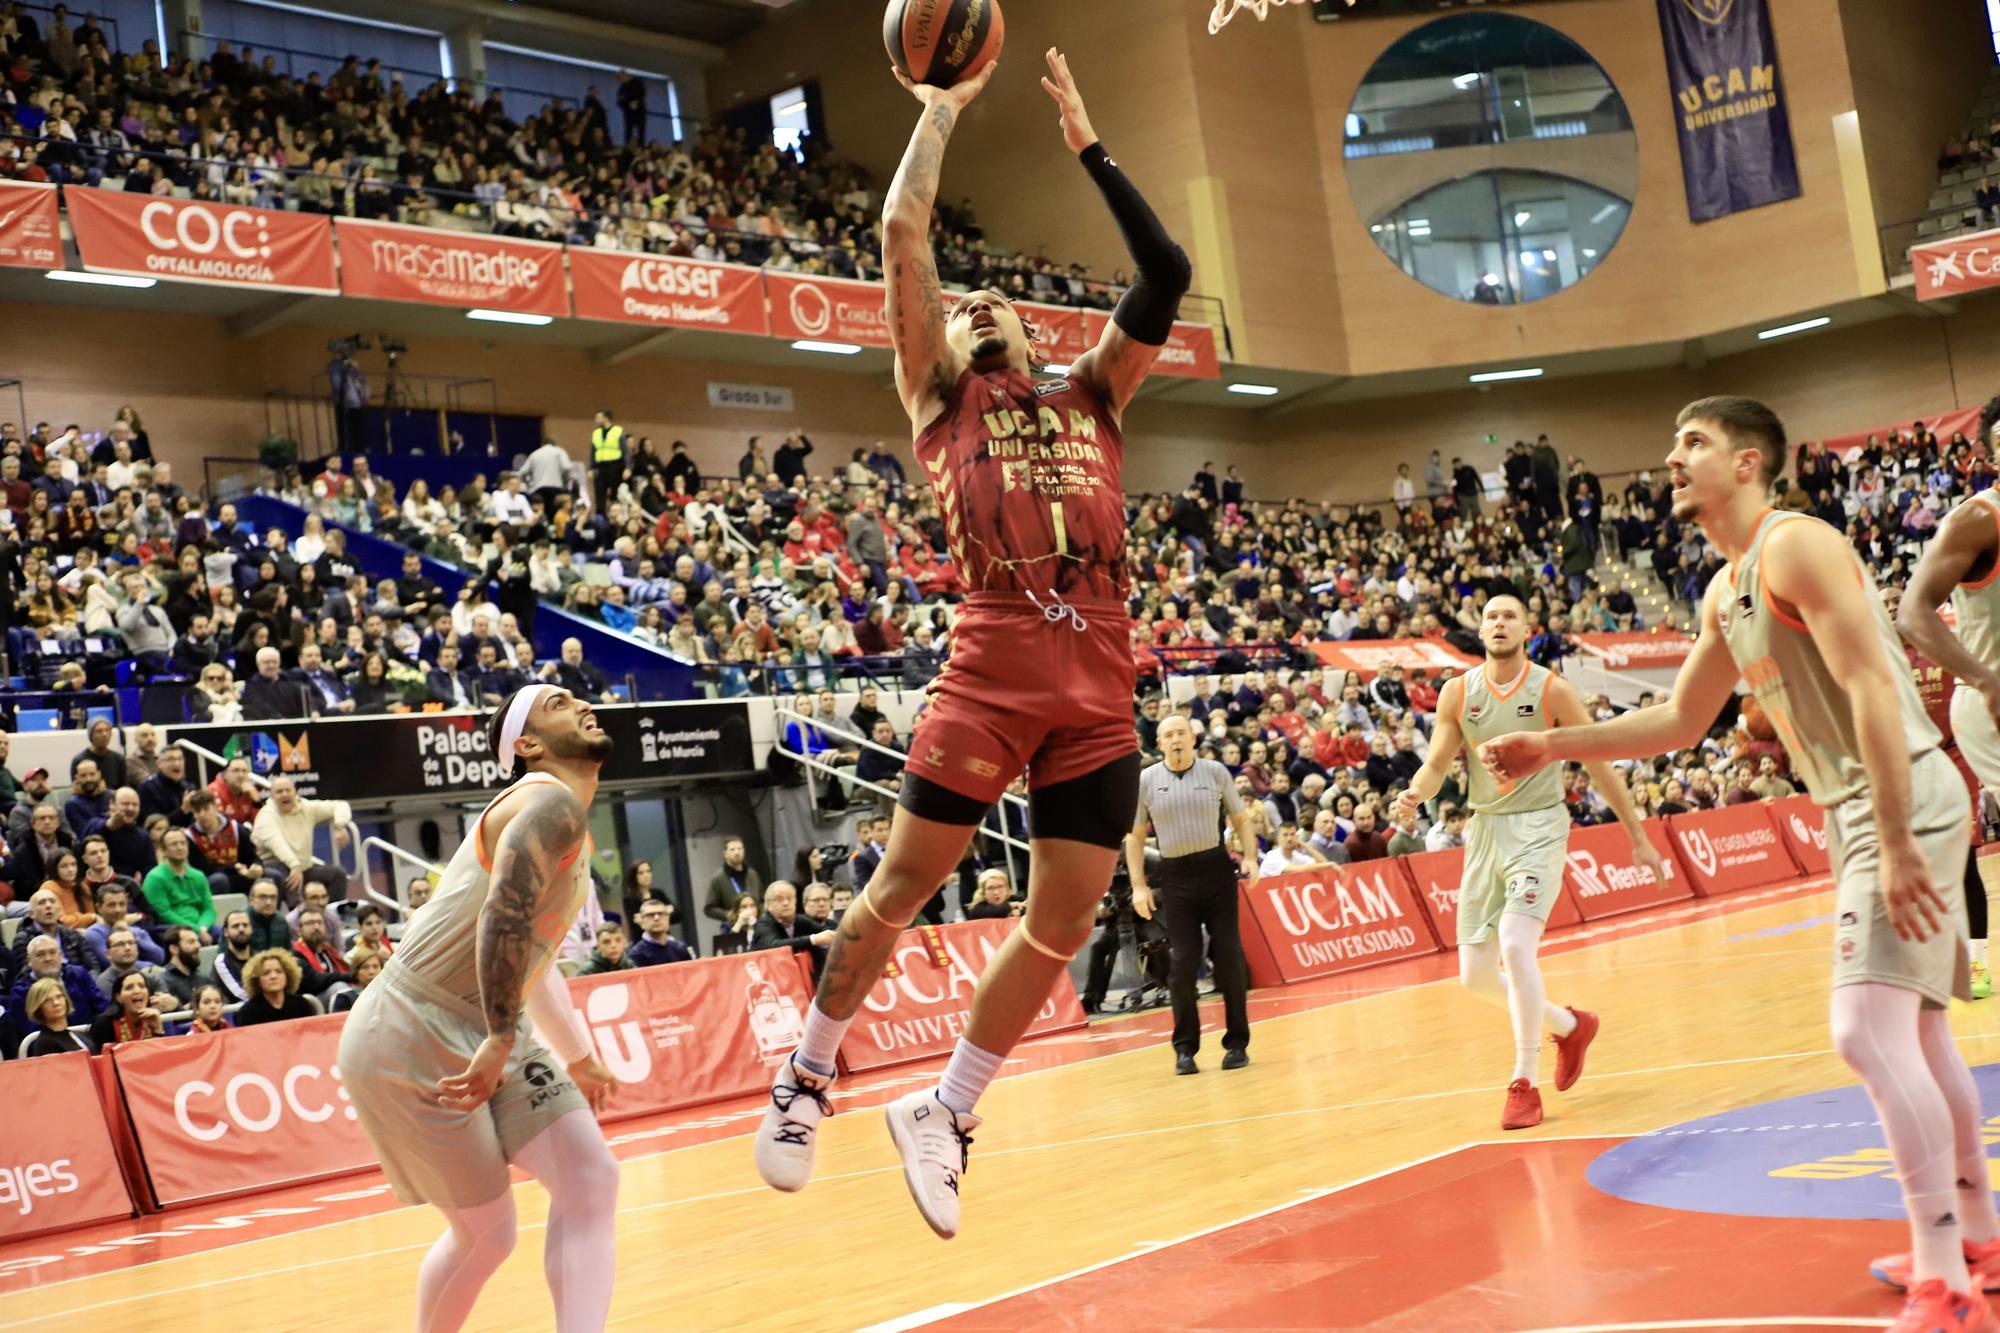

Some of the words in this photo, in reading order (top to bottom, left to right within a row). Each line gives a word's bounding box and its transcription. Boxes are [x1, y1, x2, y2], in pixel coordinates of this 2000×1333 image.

[1679, 64, 1774, 114] UCAM
[1684, 92, 1777, 131] UNIVERSIDAD
[146, 254, 275, 282] OFTALMOLOGÍA
[640, 261, 724, 299] caser
[983, 406, 1098, 443] UCAM
[1060, 474, 1087, 486] CRUZ
[657, 729, 720, 745] Ayuntamiento
[658, 747, 672, 759] de
[672, 744, 705, 758] Murcia
[423, 757, 439, 772] de
[424, 772, 443, 786] los
[1267, 873, 1403, 936] UCAM
[1293, 926, 1416, 968] UNIVERSIDAD
